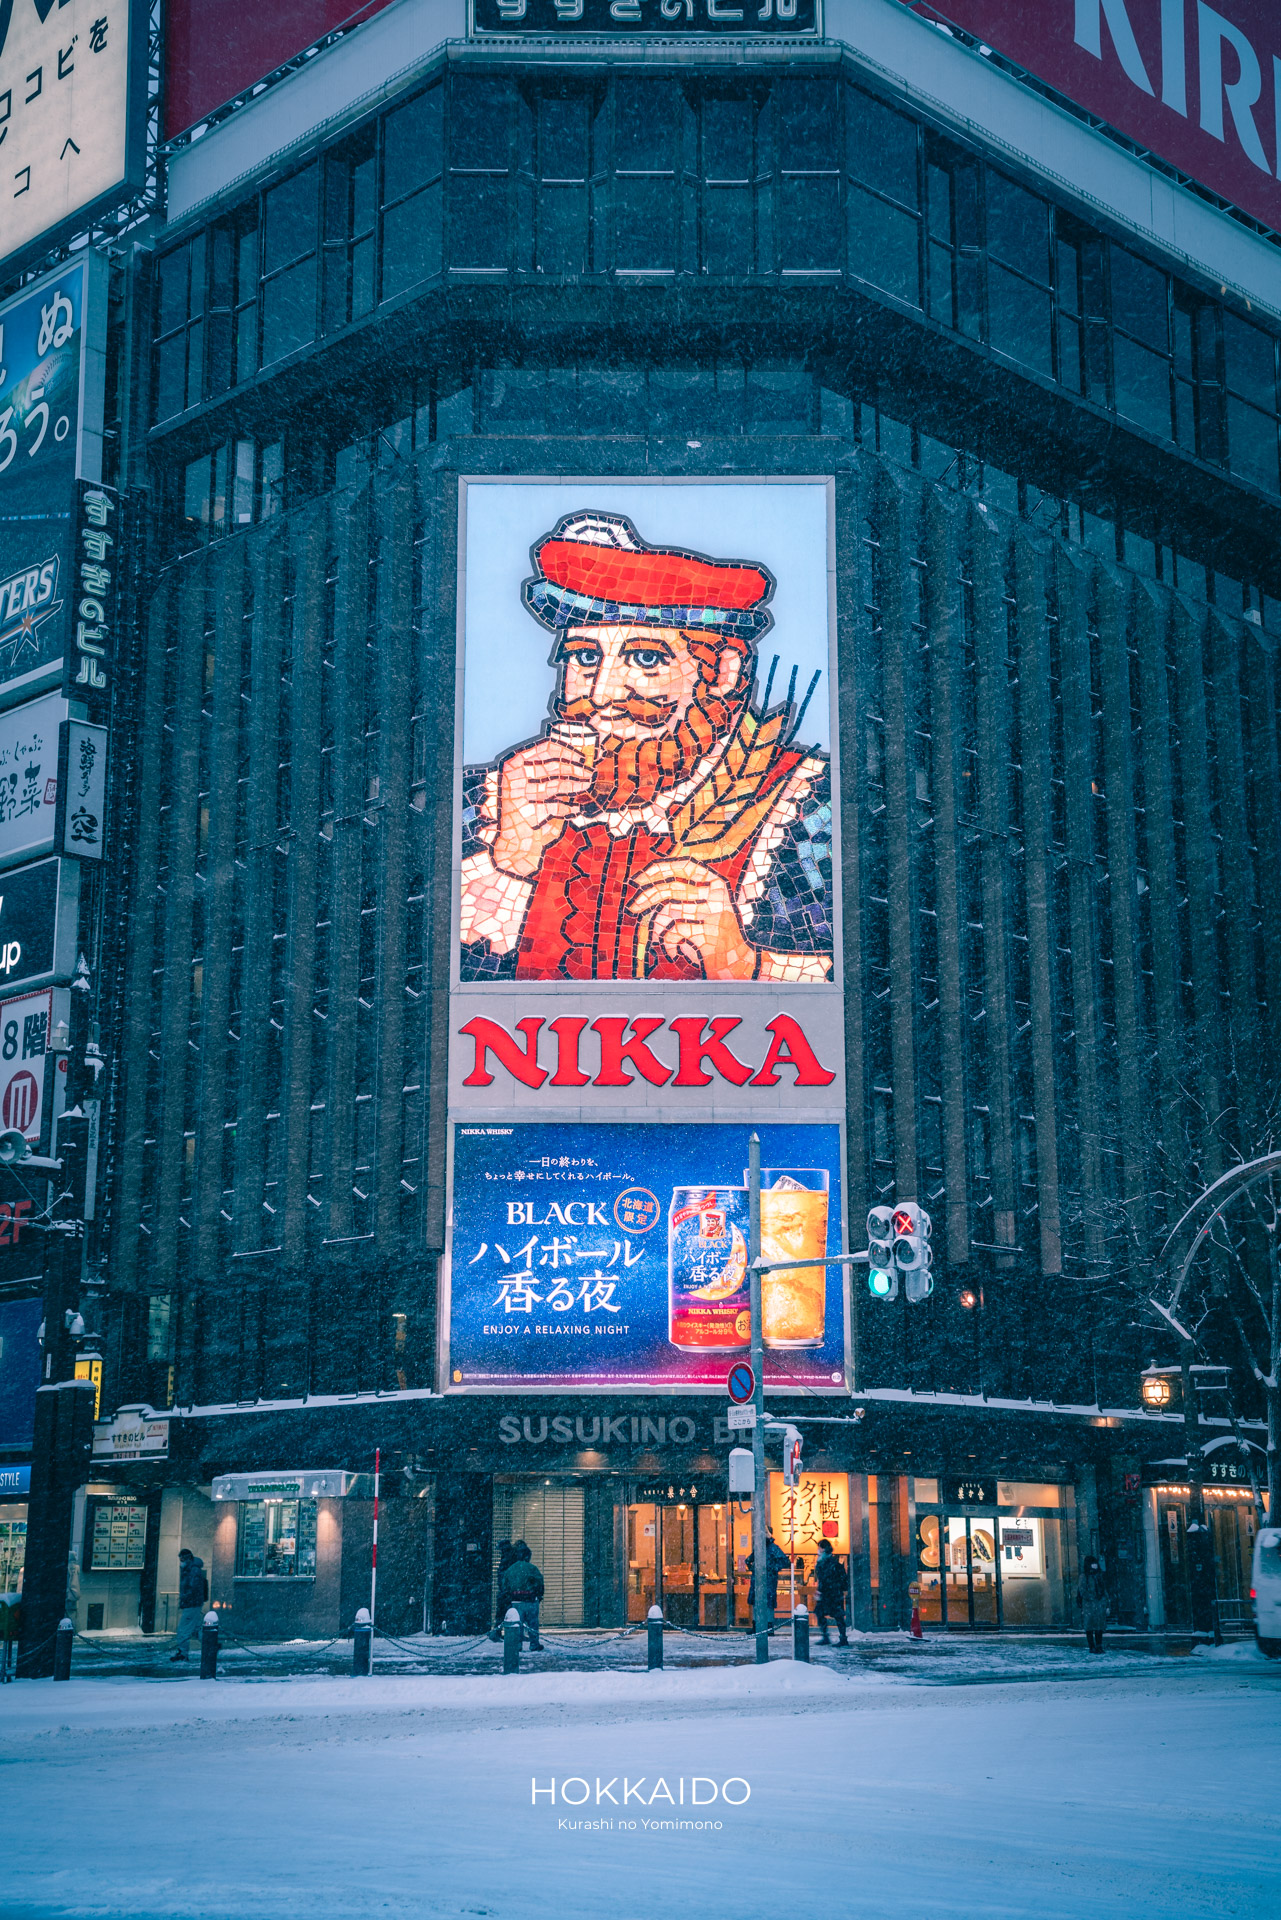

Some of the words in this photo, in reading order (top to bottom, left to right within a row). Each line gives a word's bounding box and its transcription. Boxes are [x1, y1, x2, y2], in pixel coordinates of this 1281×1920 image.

[76, 491, 114, 688] すすきのビル
[3, 1011, 48, 1061] 8階
[458, 1012, 836, 1090] NIKKA
[529, 1156, 599, 1168] 一日の終わりを、
[484, 1170, 636, 1182] ちょっと幸せにしてくれるハイボール。
[506, 1202, 610, 1225] BLACK
[621, 1197, 654, 1213] 北海道
[623, 1211, 648, 1226] 限定
[468, 1235, 646, 1269] ハイボール
[698, 1240, 728, 1249] BLACK
[682, 1251, 745, 1265] ハイボール
[689, 1264, 738, 1283] 香る夜
[492, 1269, 622, 1314] 香る夜
[483, 1325, 520, 1335] ENJOY
[523, 1325, 531, 1335] A
[535, 1325, 590, 1335] RELAXING
[595, 1325, 630, 1335] NIGHT
[111, 1432, 145, 1443] すすきのビル
[498, 1416, 696, 1443] SUSUKINO
[1210, 1462, 1264, 1478] すすきのル
[0, 1472, 20, 1487] STYLE
[818, 1481, 840, 1519] 札幌
[799, 1480, 821, 1544] タイムズ
